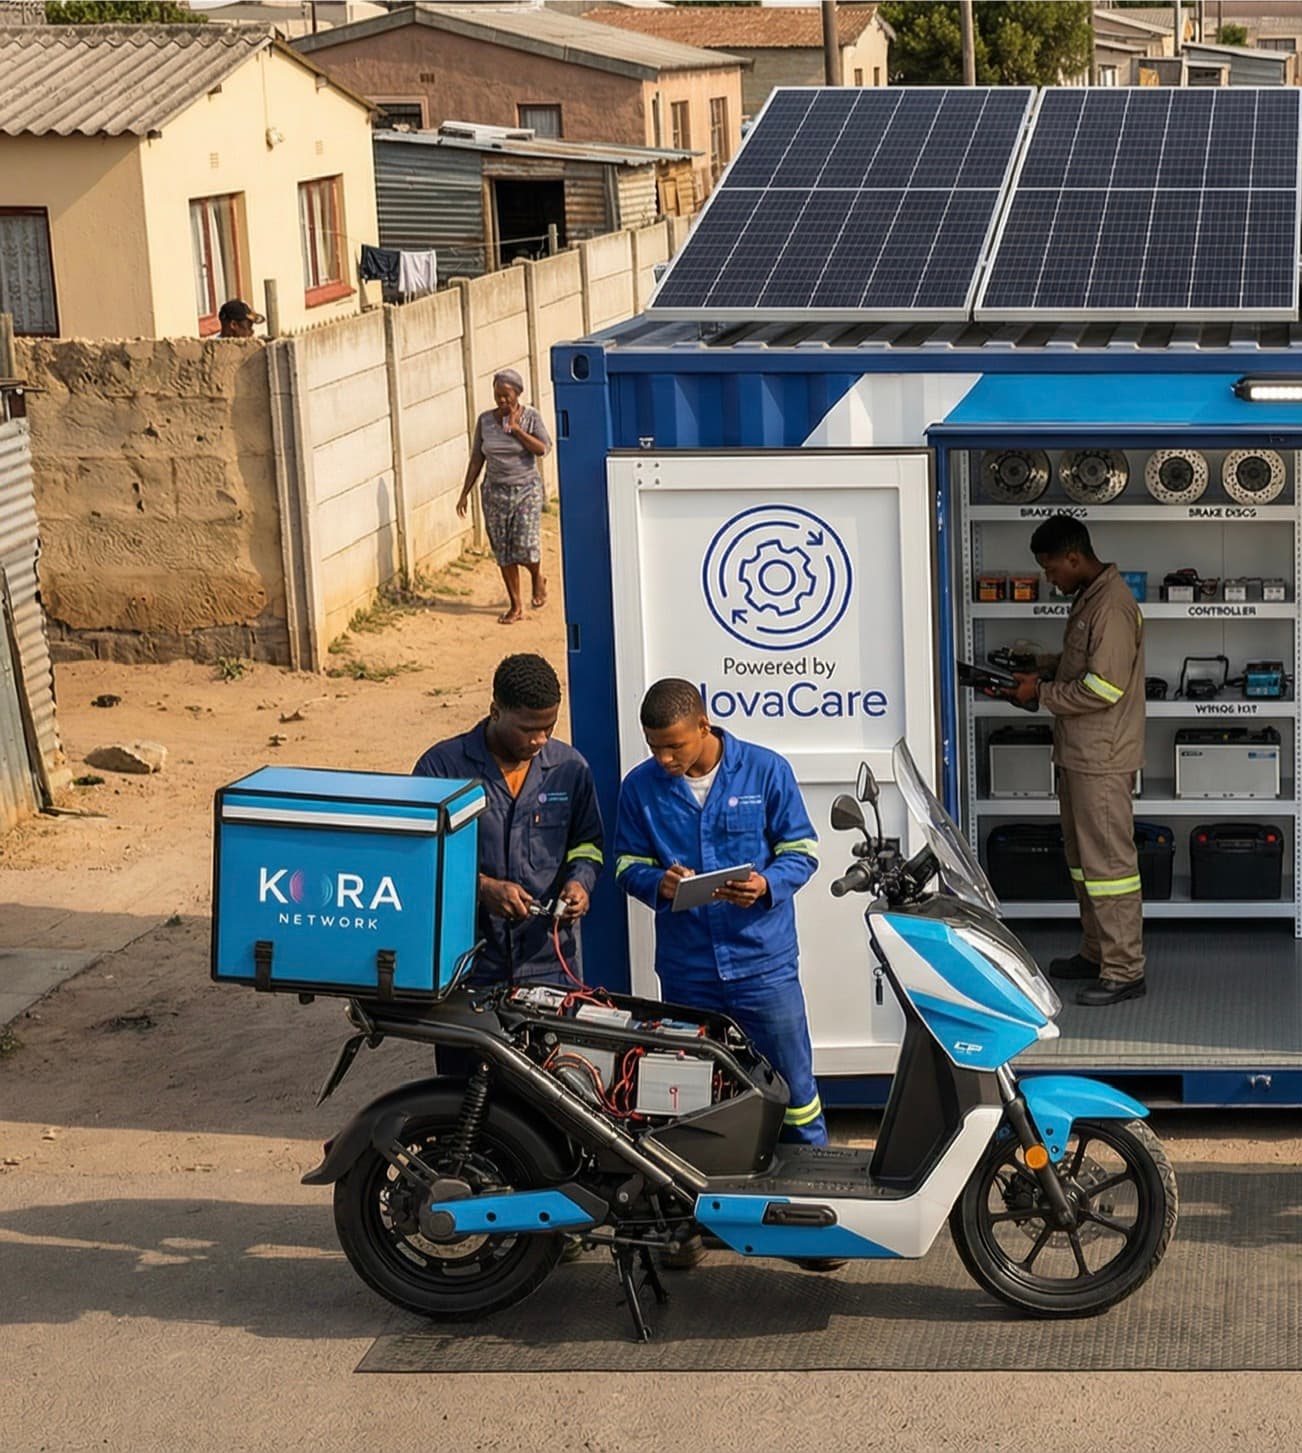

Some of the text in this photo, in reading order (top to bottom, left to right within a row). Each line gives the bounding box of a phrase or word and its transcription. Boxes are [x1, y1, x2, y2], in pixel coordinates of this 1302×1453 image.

[1020, 508, 1052, 517] BRAKE
[1188, 508, 1222, 517] BRAKE
[723, 657, 836, 679] Powered by
[279, 913, 379, 930] NETWORK
